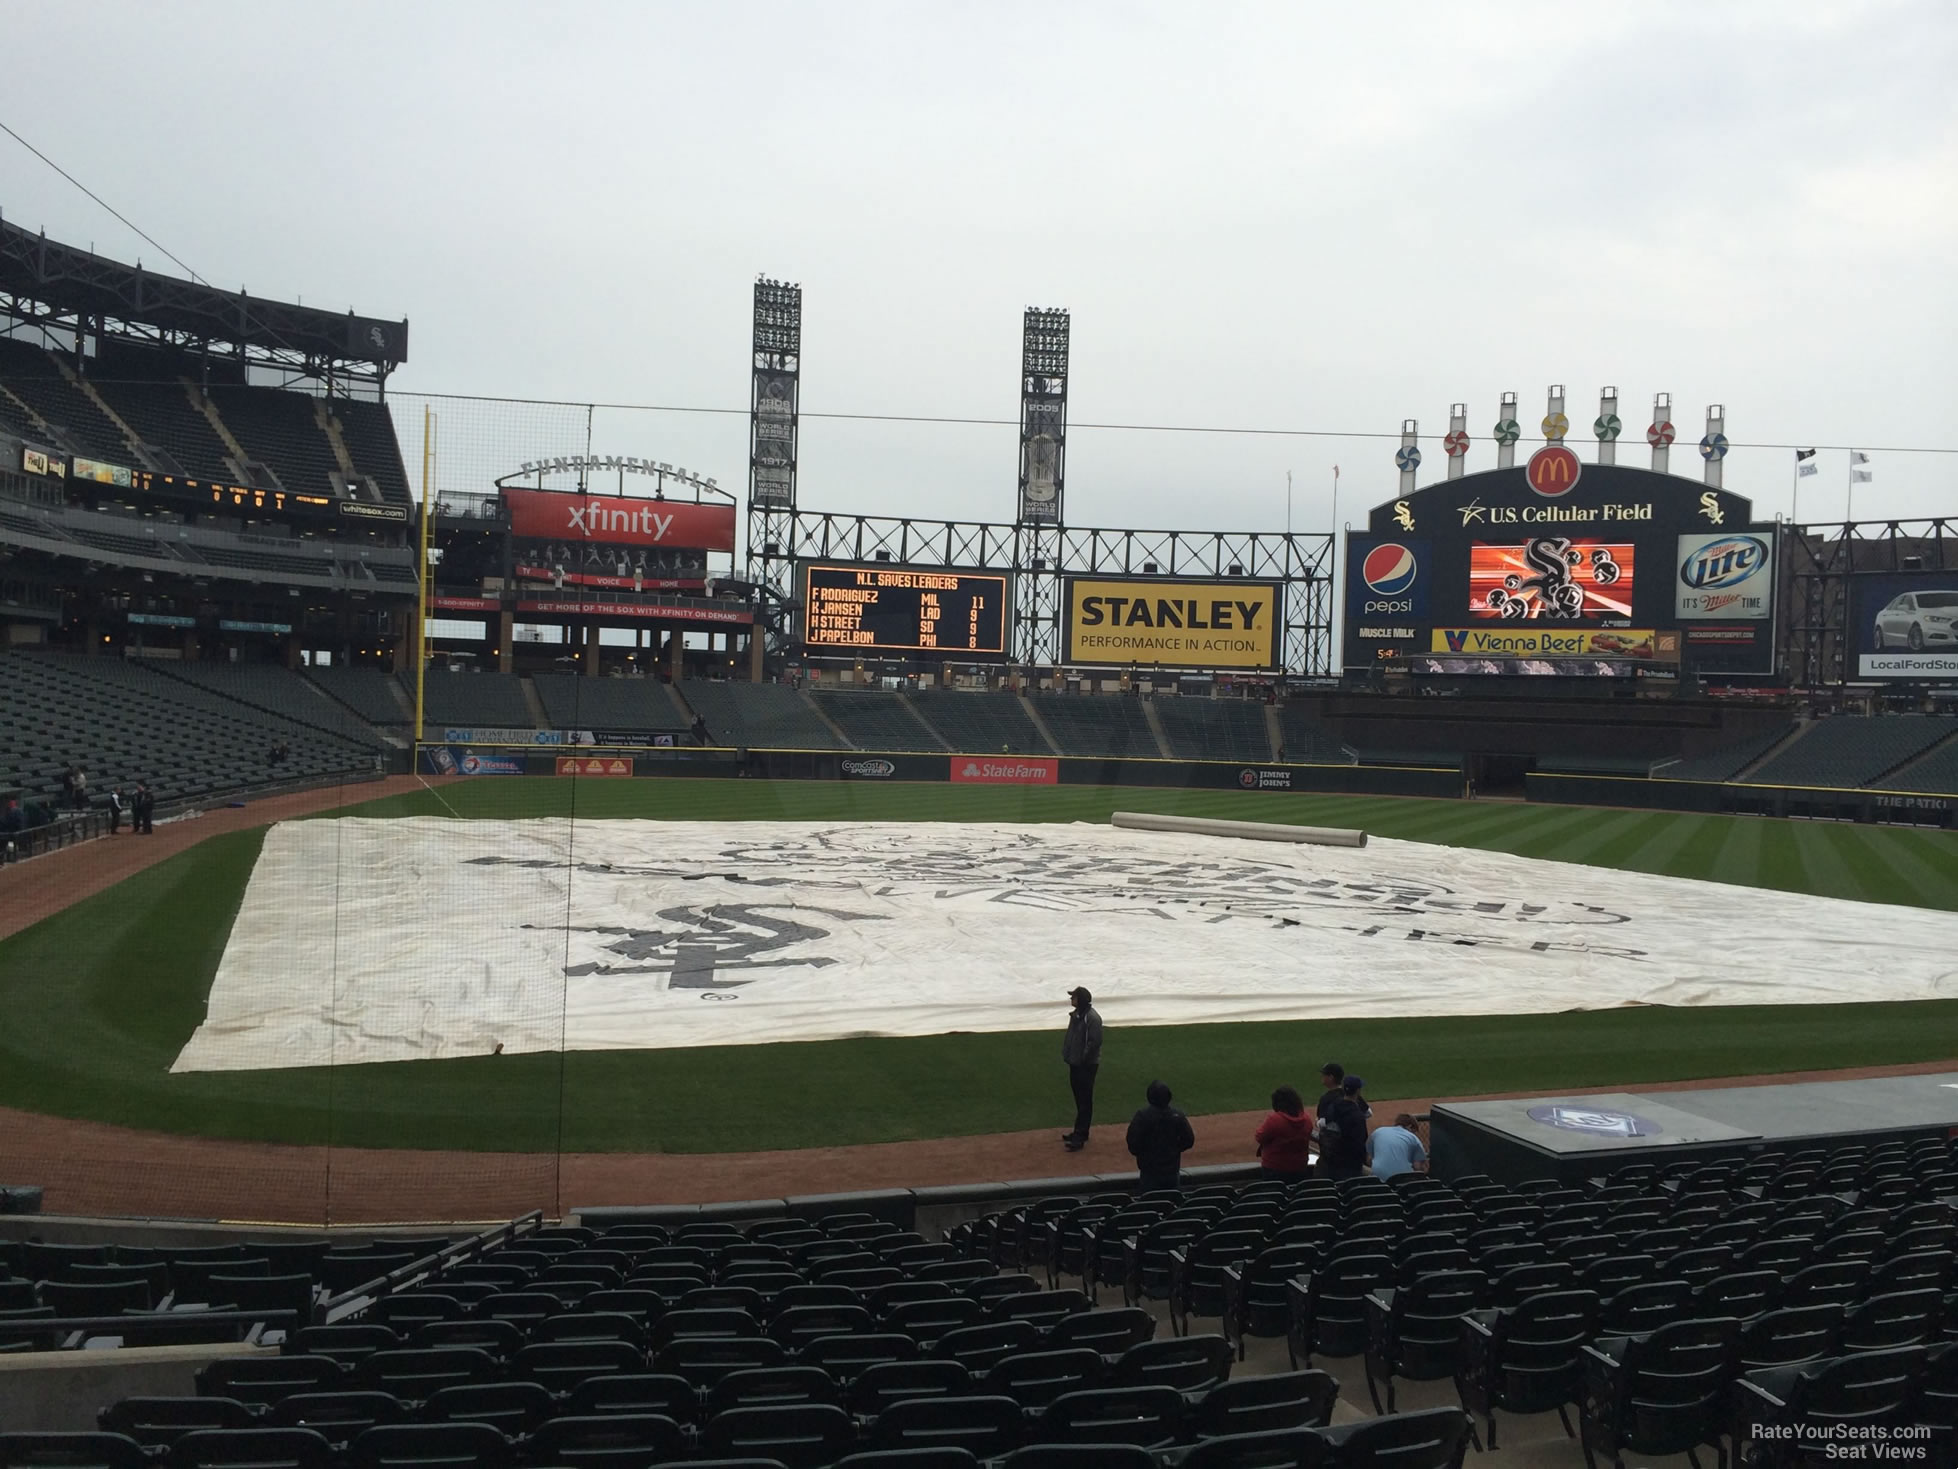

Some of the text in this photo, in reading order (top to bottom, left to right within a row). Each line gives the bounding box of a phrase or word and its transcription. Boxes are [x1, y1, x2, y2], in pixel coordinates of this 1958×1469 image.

[1029, 404, 1059, 412] 2005
[759, 423, 790, 431] WORLD
[761, 458, 788, 467] 1917
[520, 455, 717, 494] FUNDAMENTALS
[343, 505, 404, 517] whitesox.com
[1490, 503, 1653, 523] U.S. Cellular Field
[568, 502, 674, 541] xfinity
[1708, 543, 1739, 557] Miller
[1693, 546, 1757, 590] Lite
[597, 578, 620, 586] VOICE
[660, 580, 678, 588] HOME
[857, 573, 958, 590] N.L. SAVES LEADERS
[812, 588, 879, 603] F RODRIGUEZ
[921, 593, 940, 606] MIL
[812, 601, 863, 616] K JANSEN
[971, 596, 984, 609] 11
[1364, 598, 1412, 614] pepsi
[1682, 594, 1761, 612] IT'S Miller TIME
[637, 607, 659, 615] WITH
[661, 609, 693, 617] XFINITY
[708, 612, 737, 620] DEMAND
[920, 607, 940, 620] LAD
[970, 609, 977, 622] 9
[1081, 596, 1263, 630] STANLEY
[811, 615, 861, 630] H STREET
[920, 621, 934, 633] SD
[969, 622, 977, 635] 9
[811, 629, 874, 644] J PAPELBON
[1359, 628, 1414, 638] MUSCLE MILK
[919, 634, 936, 647] PHI
[969, 636, 976, 648] 8
[1081, 635, 1181, 650] PERFORMANCE
[1185, 639, 1199, 650] IN
[1473, 633, 1585, 651] Vienna Beef
[982, 763, 1046, 778] State Farm
[1260, 771, 1290, 779] JIMMY
[1259, 779, 1290, 787] JOHN'S
[1876, 797, 1903, 807] THE
